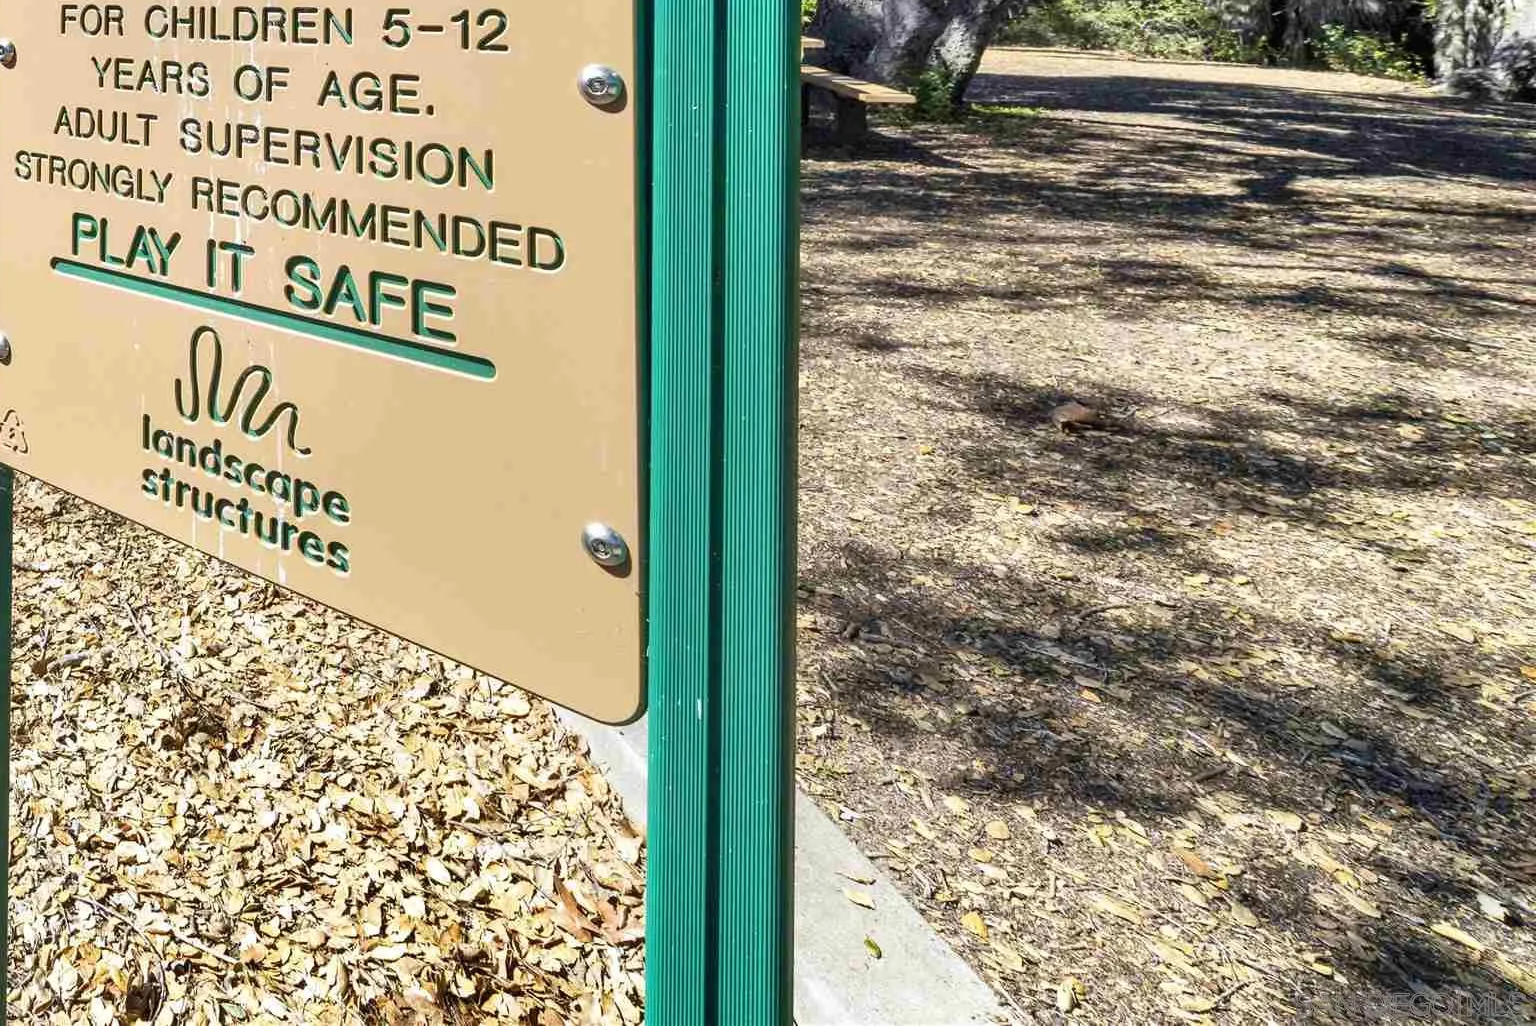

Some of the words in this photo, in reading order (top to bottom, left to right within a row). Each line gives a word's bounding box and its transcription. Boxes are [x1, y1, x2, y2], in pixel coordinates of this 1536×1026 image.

[60, 3, 124, 37] FOR
[144, 5, 353, 44] CHILDREN
[381, 8, 509, 52] 5-12
[91, 56, 209, 98] YEARS
[233, 65, 290, 102] OF
[317, 70, 435, 115] AGE.
[53, 106, 158, 148] ADULT
[179, 117, 495, 191] SUPERVISION
[13, 150, 172, 204] STRONGLY
[191, 175, 565, 273] RECOMMENDED
[71, 211, 182, 276] PLAY
[206, 238, 254, 292] IT
[284, 254, 457, 343] SAFE
[141, 413, 351, 524] landscape
[141, 465, 351, 576] structures
